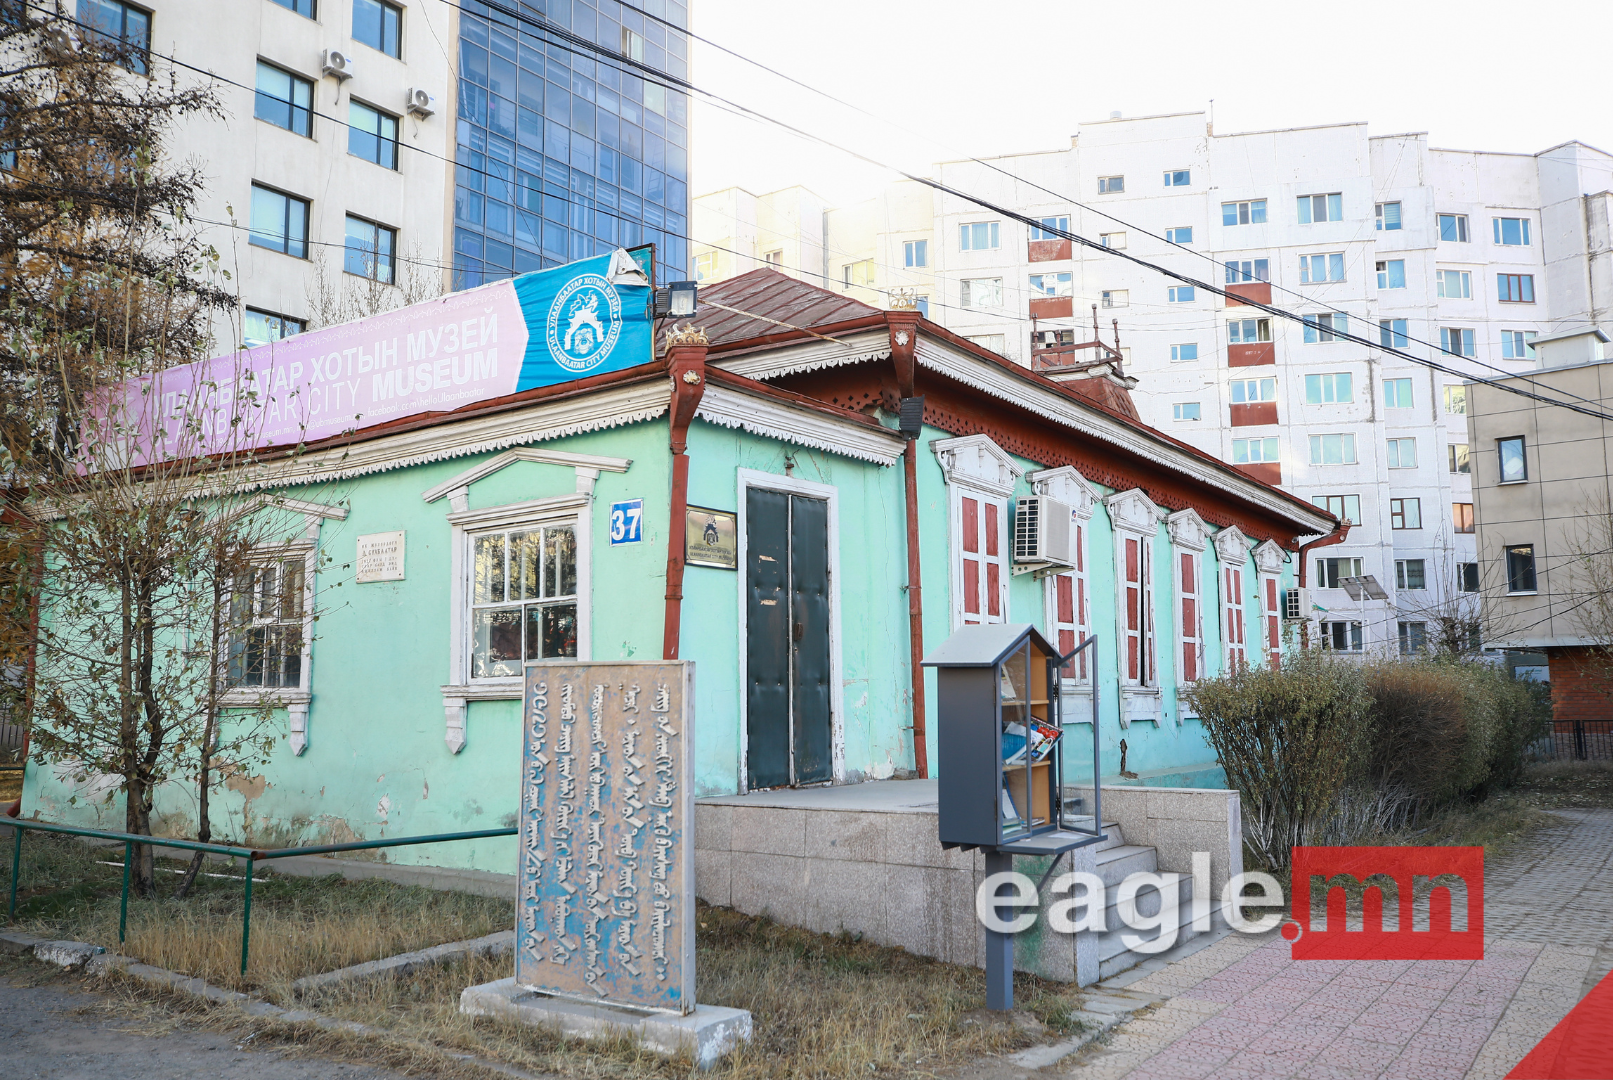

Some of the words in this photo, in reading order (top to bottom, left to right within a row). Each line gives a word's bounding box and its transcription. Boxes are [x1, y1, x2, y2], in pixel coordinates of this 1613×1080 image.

[311, 337, 397, 385] ХОТЫН
[407, 306, 498, 363] МУЗЕЙ
[549, 336, 585, 369] ULAANBAATAR
[586, 354, 601, 367] CITY
[601, 320, 620, 357] MUSEUM
[309, 377, 361, 415] CITY
[372, 347, 498, 403] MUSEUM
[611, 508, 641, 541] 37
